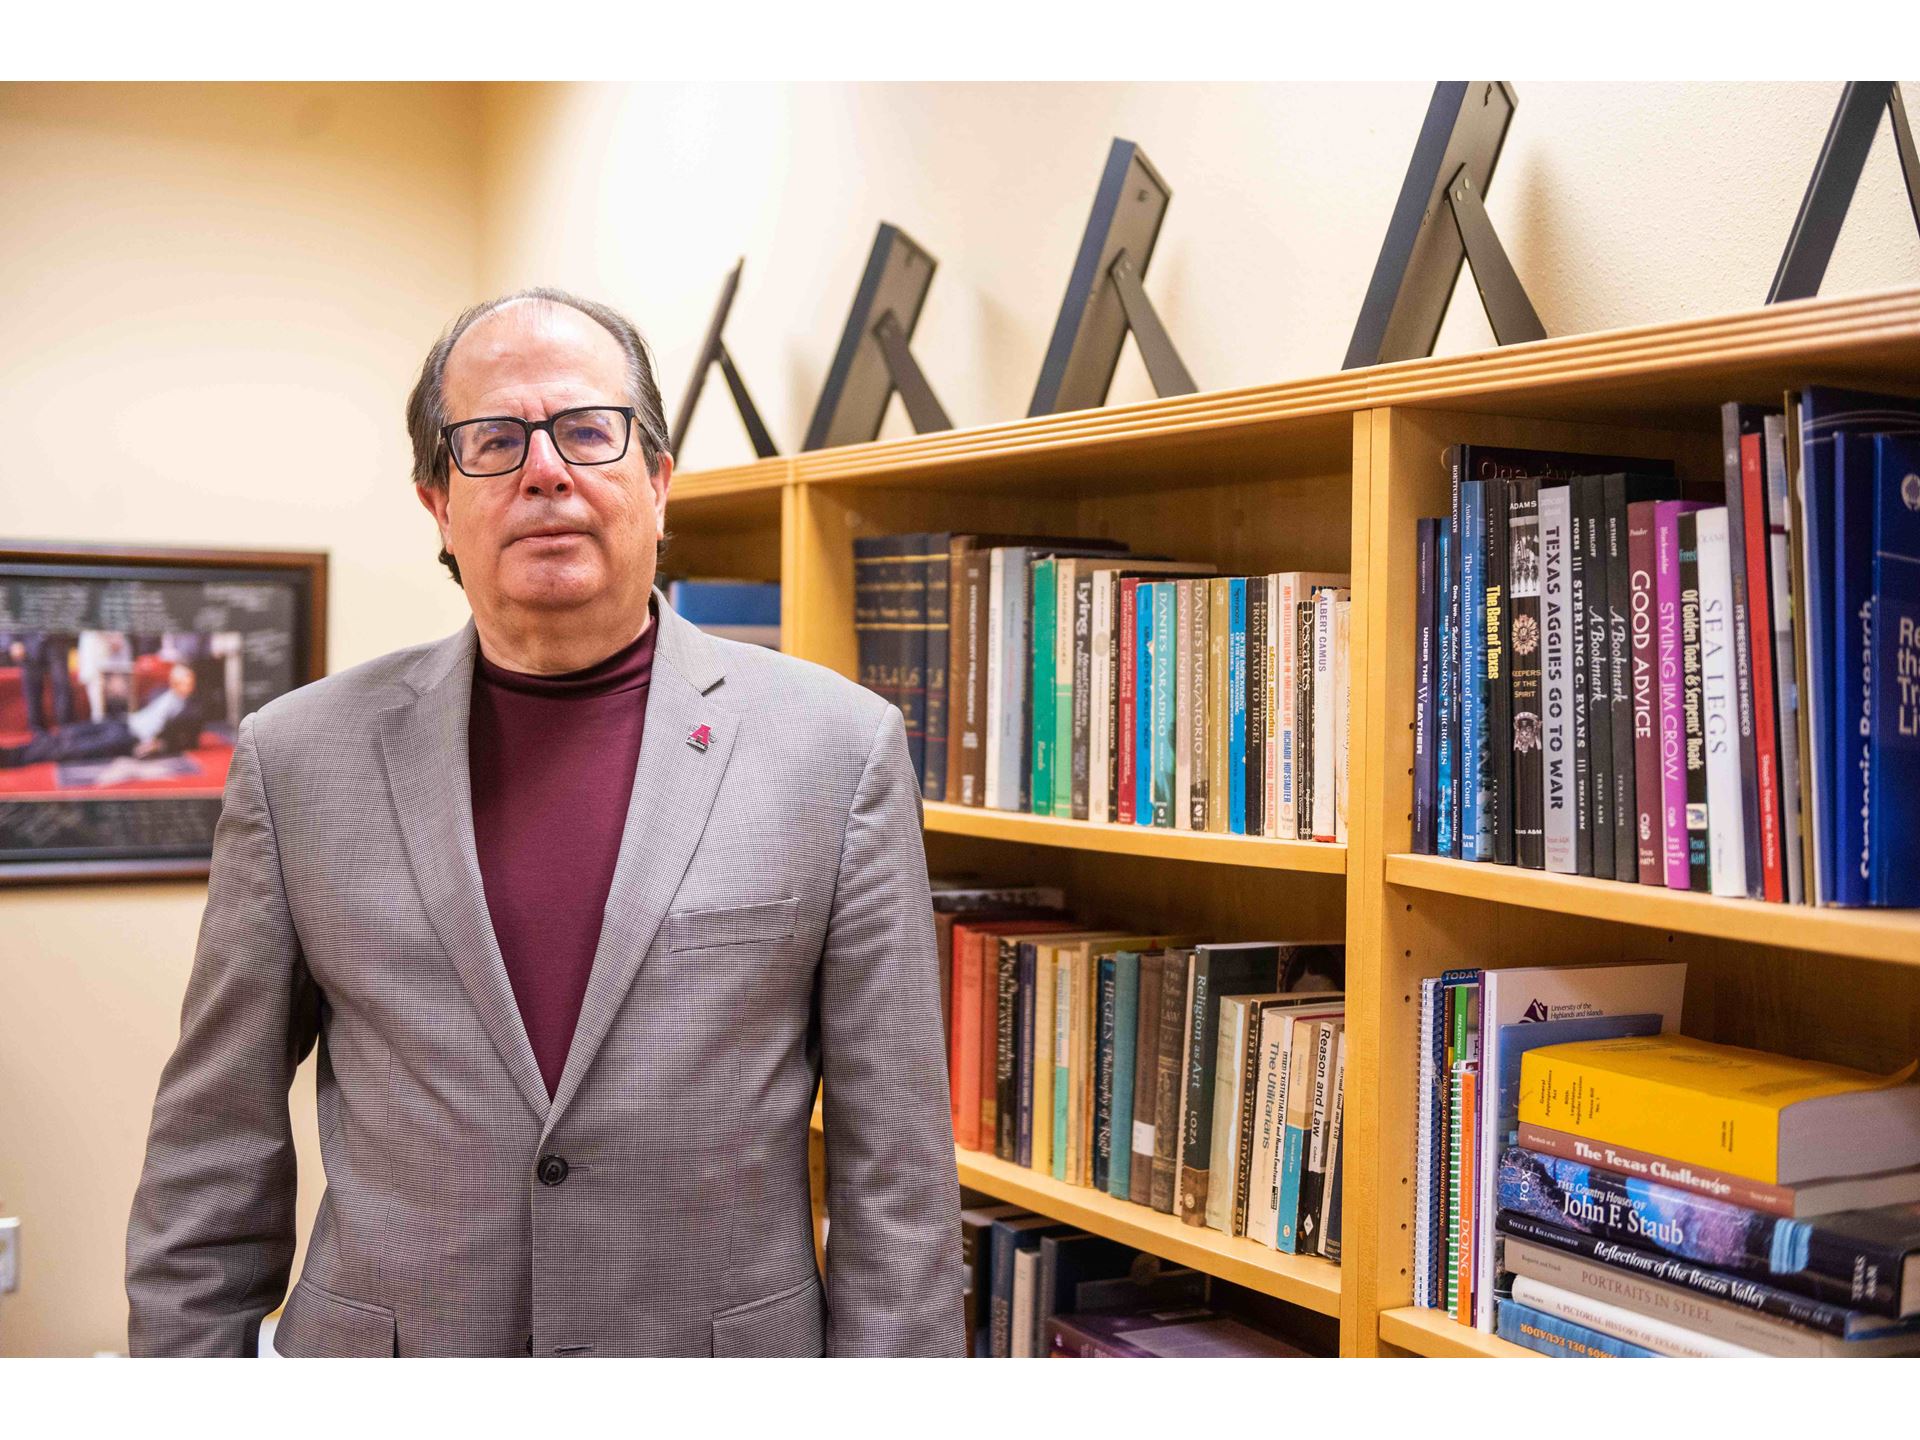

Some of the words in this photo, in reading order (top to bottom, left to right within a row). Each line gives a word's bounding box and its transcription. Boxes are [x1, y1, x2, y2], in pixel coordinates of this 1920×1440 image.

[1510, 501, 1537, 510] ADAMS
[1589, 518, 1597, 557] DETHLOFF
[1609, 517, 1617, 557] DETHLOFF
[1464, 553, 1473, 572] The
[1545, 526, 1561, 596] TEXAS
[1076, 582, 1091, 636] Lying
[1234, 587, 1242, 624] Spinoza
[1463, 575, 1473, 627] Formation
[1486, 585, 1501, 605] The
[1632, 570, 1651, 649] GOOD
[1682, 590, 1698, 601] Of
[1253, 602, 1261, 637] FROM
[1283, 586, 1292, 663] ANTI-INTELLECTUALISM
[1319, 595, 1328, 634] ALBERT
[1487, 608, 1502, 631] Bats
[1573, 580, 1584, 670] STERLING
[1682, 604, 1700, 642] Golden
[1704, 599, 1724, 659] SEA
[1075, 641, 1084, 668] Public
[1302, 609, 1313, 691] Descartes
[1319, 636, 1327, 672] CAMUS
[1463, 629, 1472, 648] and
[1487, 634, 1502, 644] of
[1546, 600, 1562, 683] AGGIES
[1660, 602, 1677, 679] STYLING
[1737, 623, 1748, 676] PRESENCE
[1081, 652, 1090, 679] Moral
[1252, 640, 1261, 682] PLATO
[1268, 646, 1276, 681] Essays
[1283, 665, 1292, 673] IN
[1463, 651, 1472, 684] Future
[1488, 647, 1502, 679] Texas
[1590, 627, 1607, 711] Bookmark
[1610, 627, 1628, 711] Bookmark
[1683, 644, 1701, 673] Toads
[1075, 671, 1084, 687] and
[1252, 685, 1261, 702] TO
[1283, 675, 1291, 711] AMERICAN
[1463, 687, 1472, 696] of
[1514, 690, 1536, 698] SPIRIT
[1575, 672, 1585, 690] C.
[1662, 682, 1678, 711] JIM
[1684, 676, 1701, 686] &
[1739, 679, 1749, 690] IN
[1075, 689, 1083, 718] Private
[1081, 682, 1089, 712] Choice
[1267, 684, 1276, 738] Unpopular
[1463, 699, 1472, 716] the
[1548, 686, 1563, 720] GO
[1633, 657, 1651, 738] ADVICE
[1685, 688, 1703, 735] Serpents'
[1707, 674, 1728, 753] LEGS
[1740, 693, 1751, 736] MEXICO
[1074, 721, 1083, 738] Life
[1081, 715, 1089, 726] in
[1252, 705, 1260, 746] HEGEL
[1283, 713, 1291, 726] LIFE
[1416, 685, 1428, 755] WEATHER
[1462, 719, 1472, 747] Upper
[1576, 692, 1586, 748] EVANS
[1283, 730, 1292, 759] RICHARD
[1549, 723, 1563, 754] TO
[1663, 714, 1680, 780] CROW
[1686, 738, 1704, 770] Roads
[1267, 742, 1275, 779] Russell
[1462, 750, 1472, 777] Texas
[1283, 762, 1292, 802] HOFSTADTER
[1462, 780, 1471, 808] Coast
[1549, 757, 1564, 810] WAR
[1444, 970, 1479, 981] TODAY
[1192, 975, 1207, 1041] Religion
[1551, 1004, 1576, 1012] University
[1551, 1011, 1575, 1019] Highlands
[1194, 1044, 1202, 1059] as
[1245, 1058, 1254, 1078] DER
[1269, 1042, 1280, 1071] The
[1317, 1028, 1331, 1078] Reason
[1192, 1060, 1205, 1088] Art
[1262, 1073, 1278, 1150] Utilitarians
[1278, 1072, 1287, 1125] EXISTENTIALISM
[1315, 1081, 1325, 1107] and
[1190, 1110, 1198, 1145] LOZA
[1241, 1092, 1253, 1134] SARTRE
[1312, 1109, 1324, 1138] Law
[1237, 1137, 1249, 1200] JEAN-PAUL
[1519, 1169, 1532, 1202] FOX
[1574, 1142, 1602, 1161] The
[1605, 1149, 1648, 1174] Texas
[1650, 1162, 1731, 1196] Challenge
[1439, 1160, 1447, 1226] ADMINISTRATION
[1557, 1180, 1575, 1193] THE
[1575, 1181, 1606, 1202] Country
[1606, 1191, 1632, 1209] Houses
[1632, 1200, 1647, 1211] OF
[1508, 1218, 1528, 1231] STEELE
[1528, 1225, 1534, 1233] &
[1534, 1228, 1579, 1247] KILLINGSWORTH
[1562, 1191, 1605, 1224] John
[1609, 1204, 1622, 1229] F.
[1627, 1210, 1684, 1245] Staub
[1460, 1218, 1470, 1278] DOING
[1593, 1241, 1652, 1271] Reflections
[1654, 1259, 1669, 1278] of
[1669, 1264, 1688, 1281] the
[1689, 1270, 1729, 1295] Brazos
[1730, 1281, 1767, 1309] Valley
[1581, 1270, 1654, 1304] PORTRAITS
[1654, 1292, 1669, 1308] IN
[1673, 1298, 1713, 1323] STEEL
[1563, 1304, 1602, 1325] PICTORIAL
[1605, 1318, 1639, 1339] HISTORY
